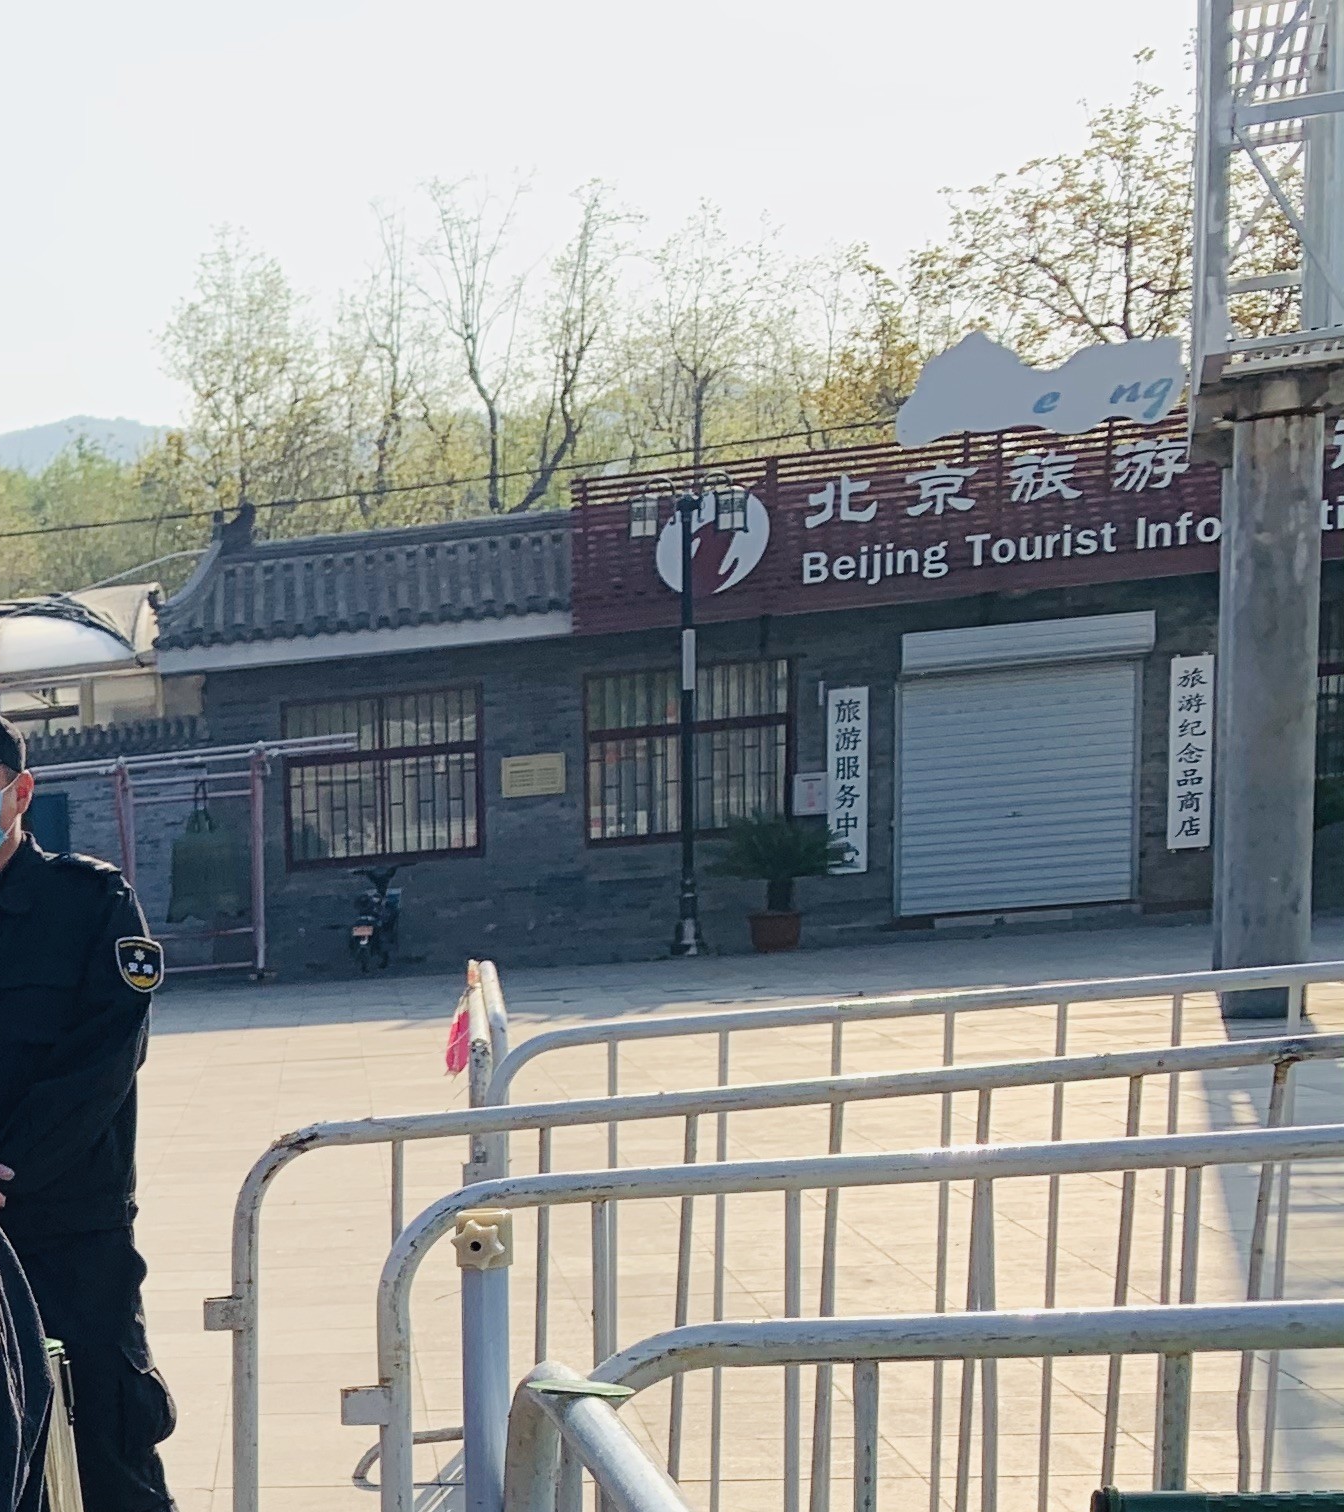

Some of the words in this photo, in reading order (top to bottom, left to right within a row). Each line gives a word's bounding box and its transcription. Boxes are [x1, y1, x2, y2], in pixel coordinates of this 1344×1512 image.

[802, 541, 949, 587] Beijing
[965, 521, 1117, 567] Tourist
[1174, 667, 1208, 838] 旅游纪念品商店
